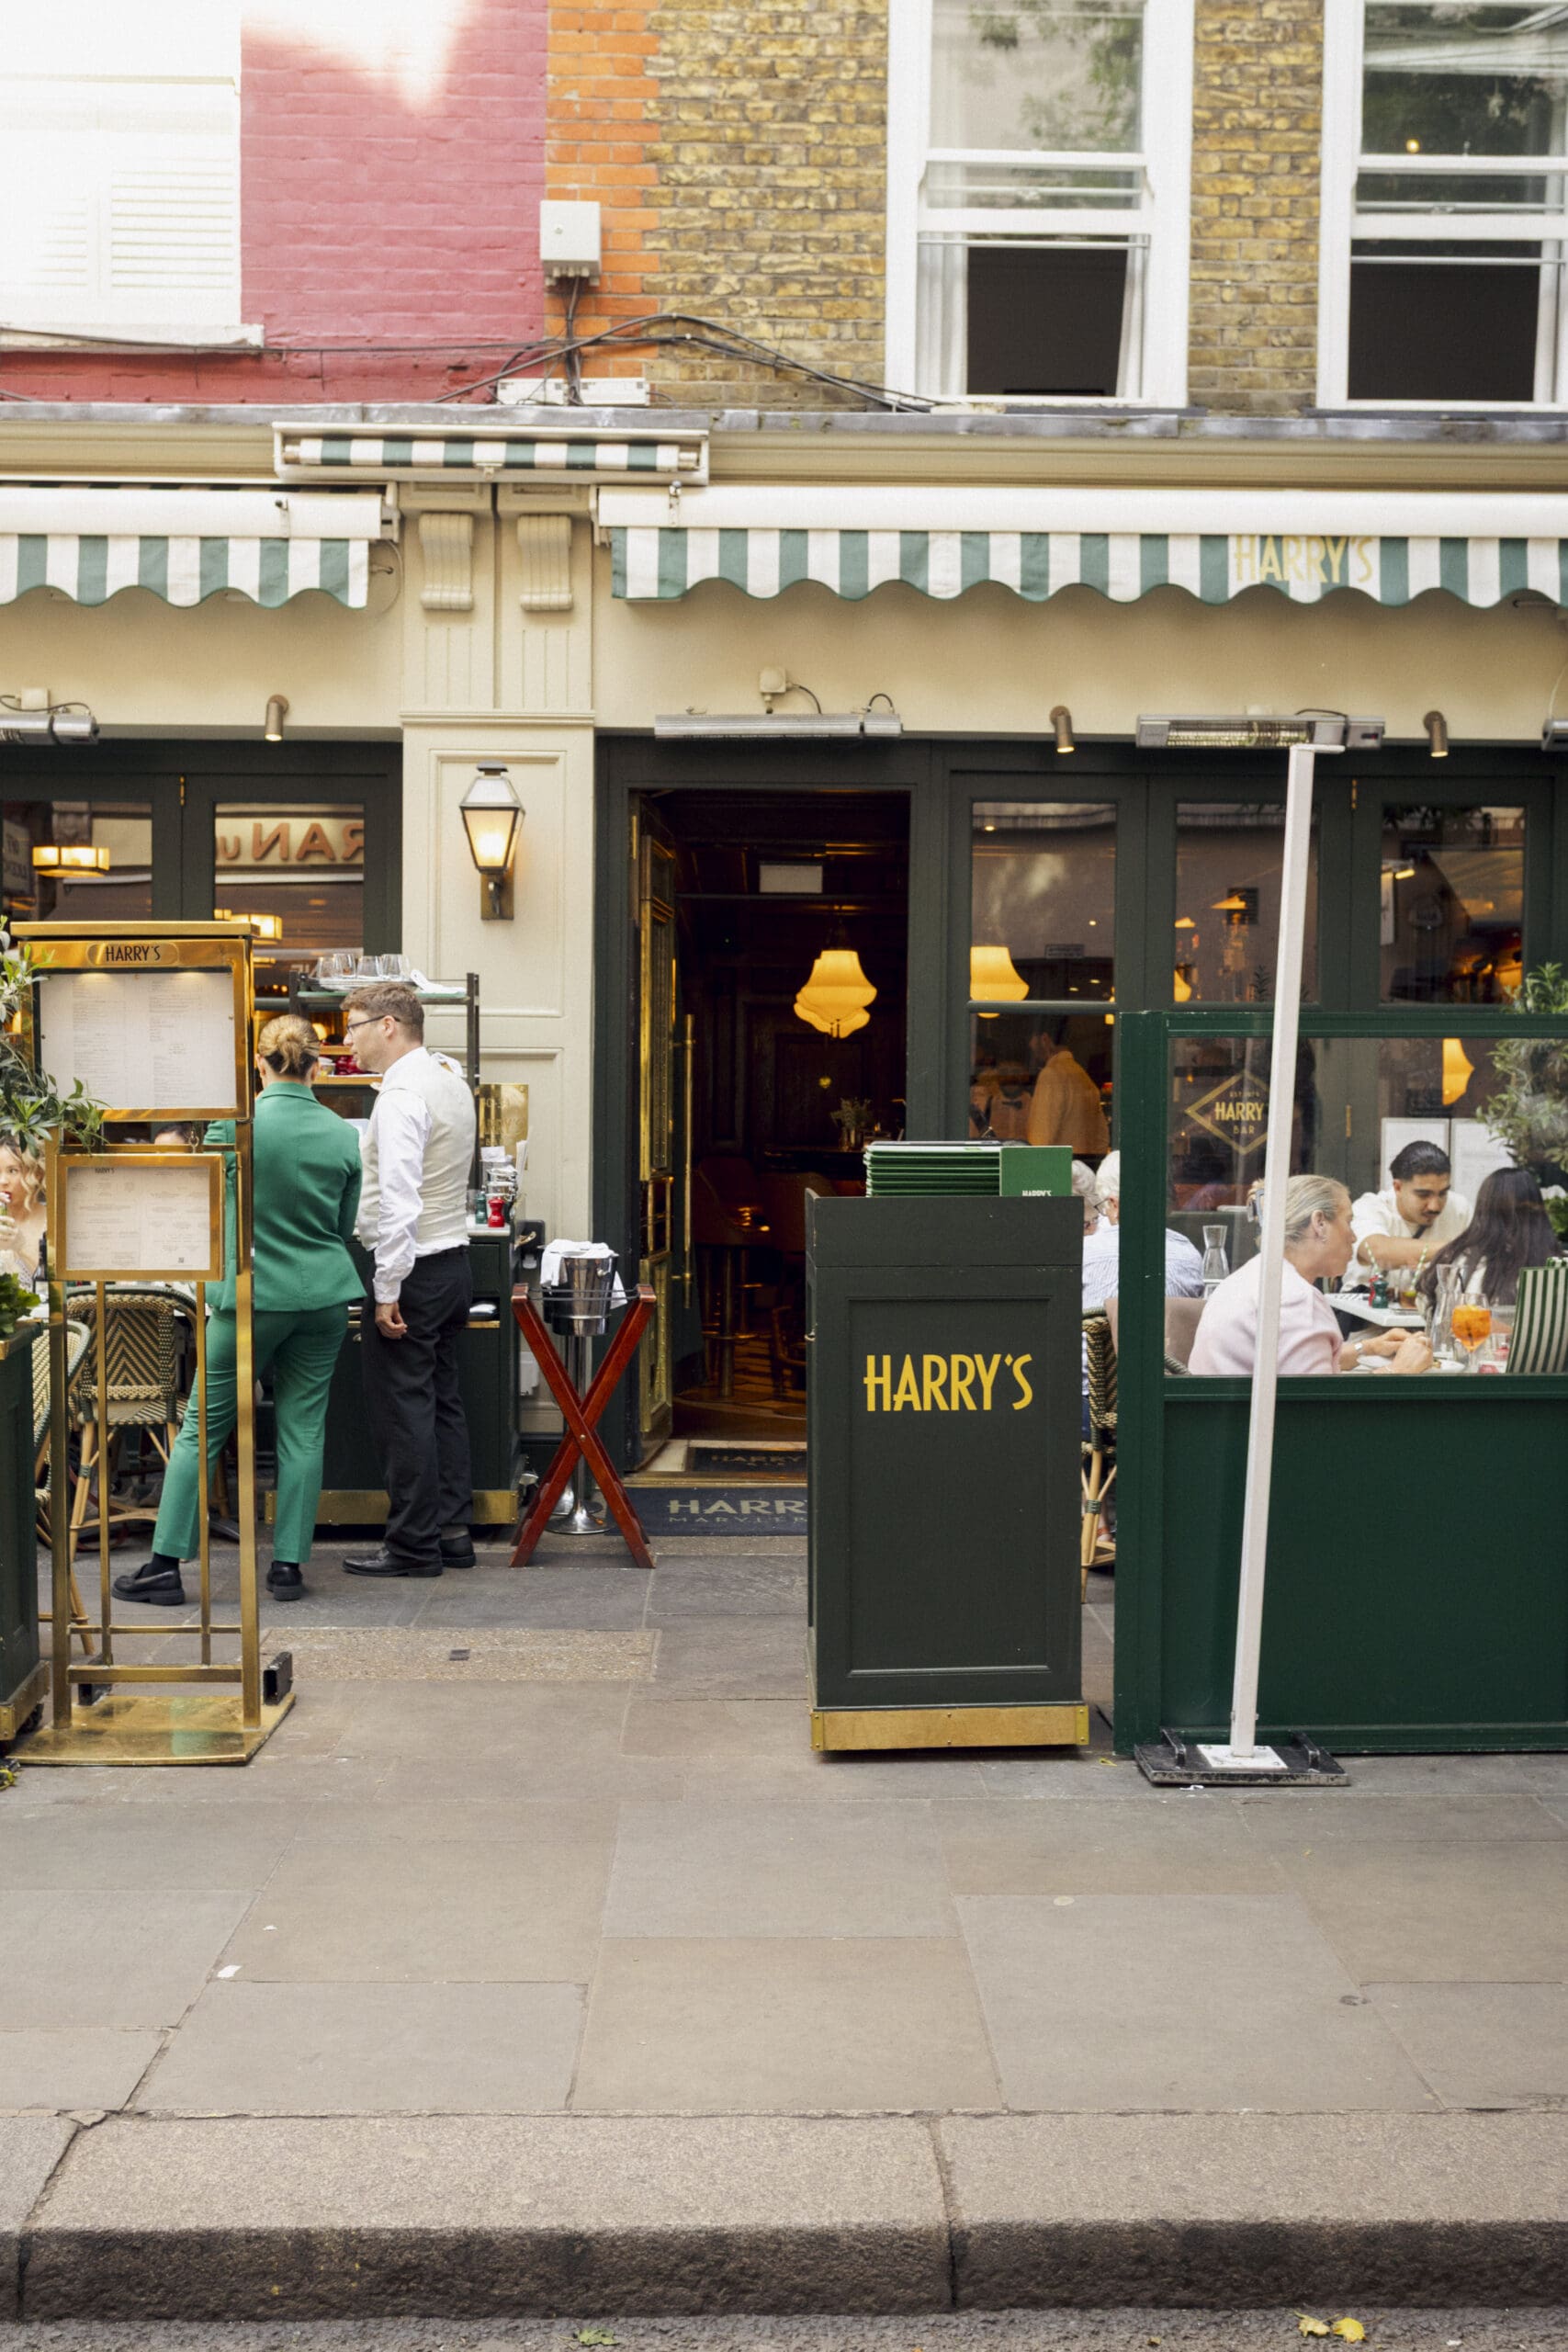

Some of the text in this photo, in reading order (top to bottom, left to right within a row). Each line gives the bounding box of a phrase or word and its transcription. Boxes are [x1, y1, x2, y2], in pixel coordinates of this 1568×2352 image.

[1235, 536, 1373, 583] HARRY'S
[106, 944, 161, 962] HARRY'S
[1233, 1125, 1255, 1135] BAR
[863, 1353, 1033, 1412] HARRY'S
[667, 1499, 807, 1515] HARR
